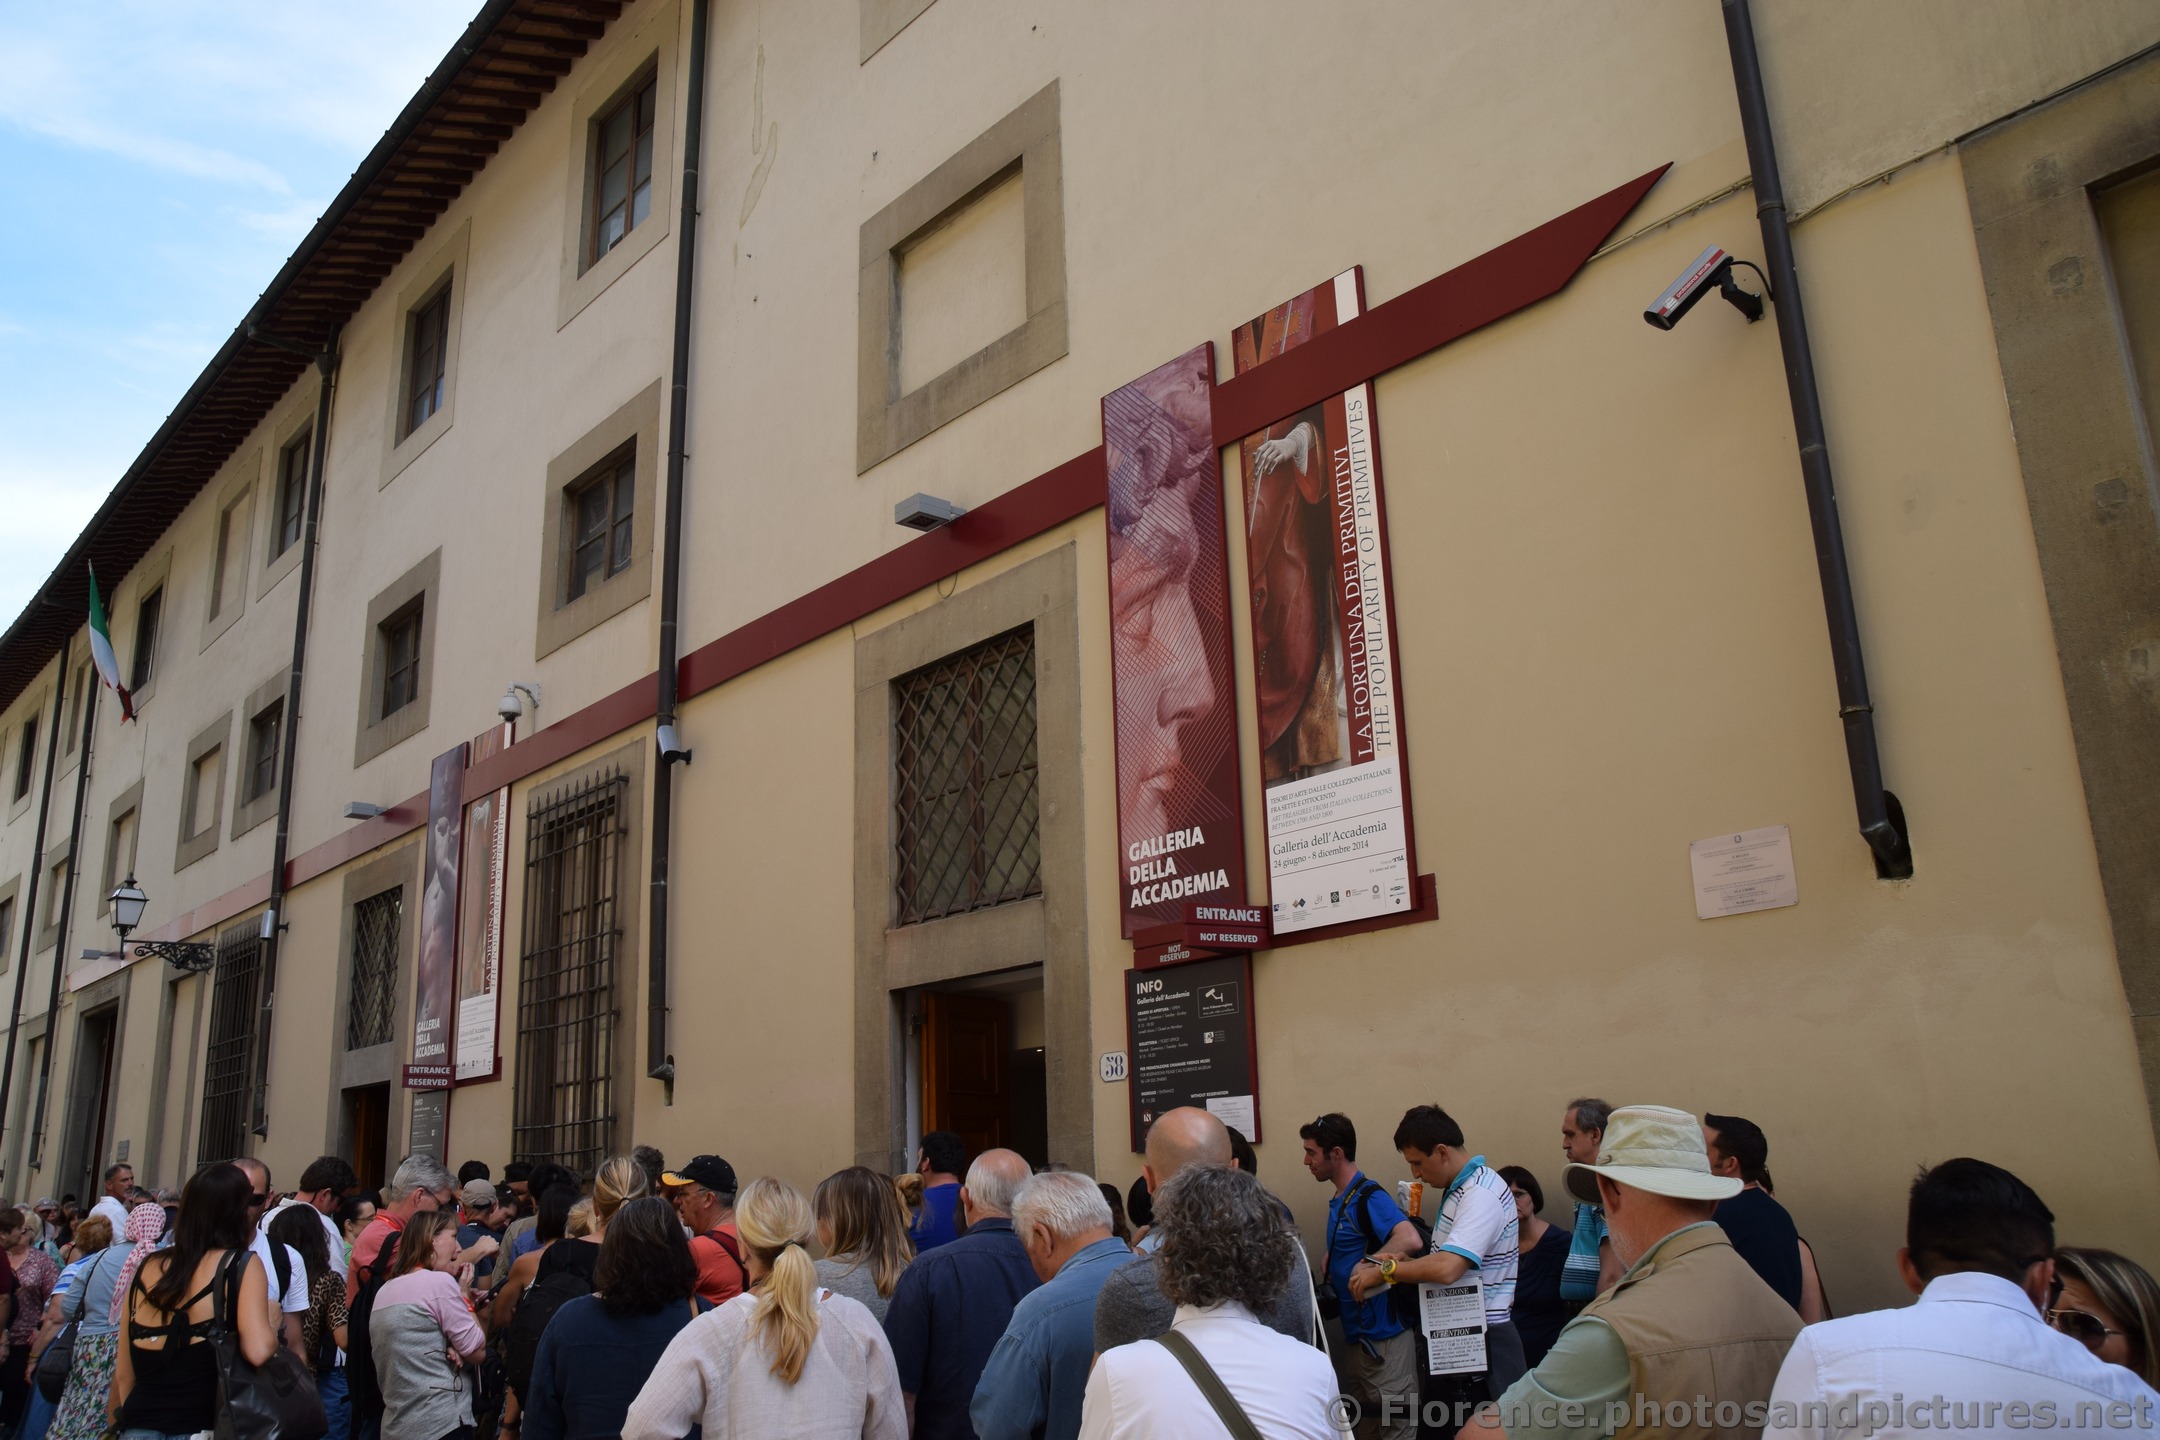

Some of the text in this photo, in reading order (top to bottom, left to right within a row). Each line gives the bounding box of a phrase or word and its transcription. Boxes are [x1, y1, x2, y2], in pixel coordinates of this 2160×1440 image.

[1348, 400, 1391, 752] THE POPULARITY OF PRIMITIVES
[1334, 444, 1372, 757] LA FORTUNA DEI PRIMITIVI
[1270, 768, 1392, 804] TESORI D'ARTE DALLE COLLEZIONI ITALIANE
[1282, 802, 1296, 810] SETTE
[1302, 792, 1336, 805] OTTOCENTO
[1282, 807, 1312, 819] TREASURES
[1313, 803, 1328, 812] FROM
[1330, 796, 1351, 808] ITALIAN
[1353, 787, 1392, 802] COLLECTIONS
[497, 794, 506, 862] PRIMITIVES
[1272, 819, 1296, 830] BETWEEN
[1129, 826, 1205, 862] GALLERIA
[1273, 839, 1309, 855] Galleria
[1274, 860, 1281, 868] 24
[1283, 855, 1306, 868] giugno
[1318, 844, 1350, 858] dicembre
[1352, 840, 1369, 850] 2014
[496, 867, 501, 881] OF
[1130, 856, 1177, 885] DELLA
[1130, 869, 1229, 908] ACCADEMIA
[491, 884, 500, 963] POPULARITY
[1196, 907, 1260, 922] ENTRANCE
[486, 909, 495, 970] FORTUNA
[1200, 933, 1258, 943] NOT RESERVED
[1160, 951, 1190, 963] RESERVED
[1168, 944, 1181, 953] NOT
[485, 972, 491, 990] LA
[1136, 979, 1163, 994] INFO
[417, 1018, 440, 1032] GALLERIA
[416, 1032, 430, 1046] DELLA
[416, 1042, 445, 1058] ACCADEMIA
[1106, 1055, 1124, 1078] 58
[1432, 1328, 1470, 1338] ATTENTION
